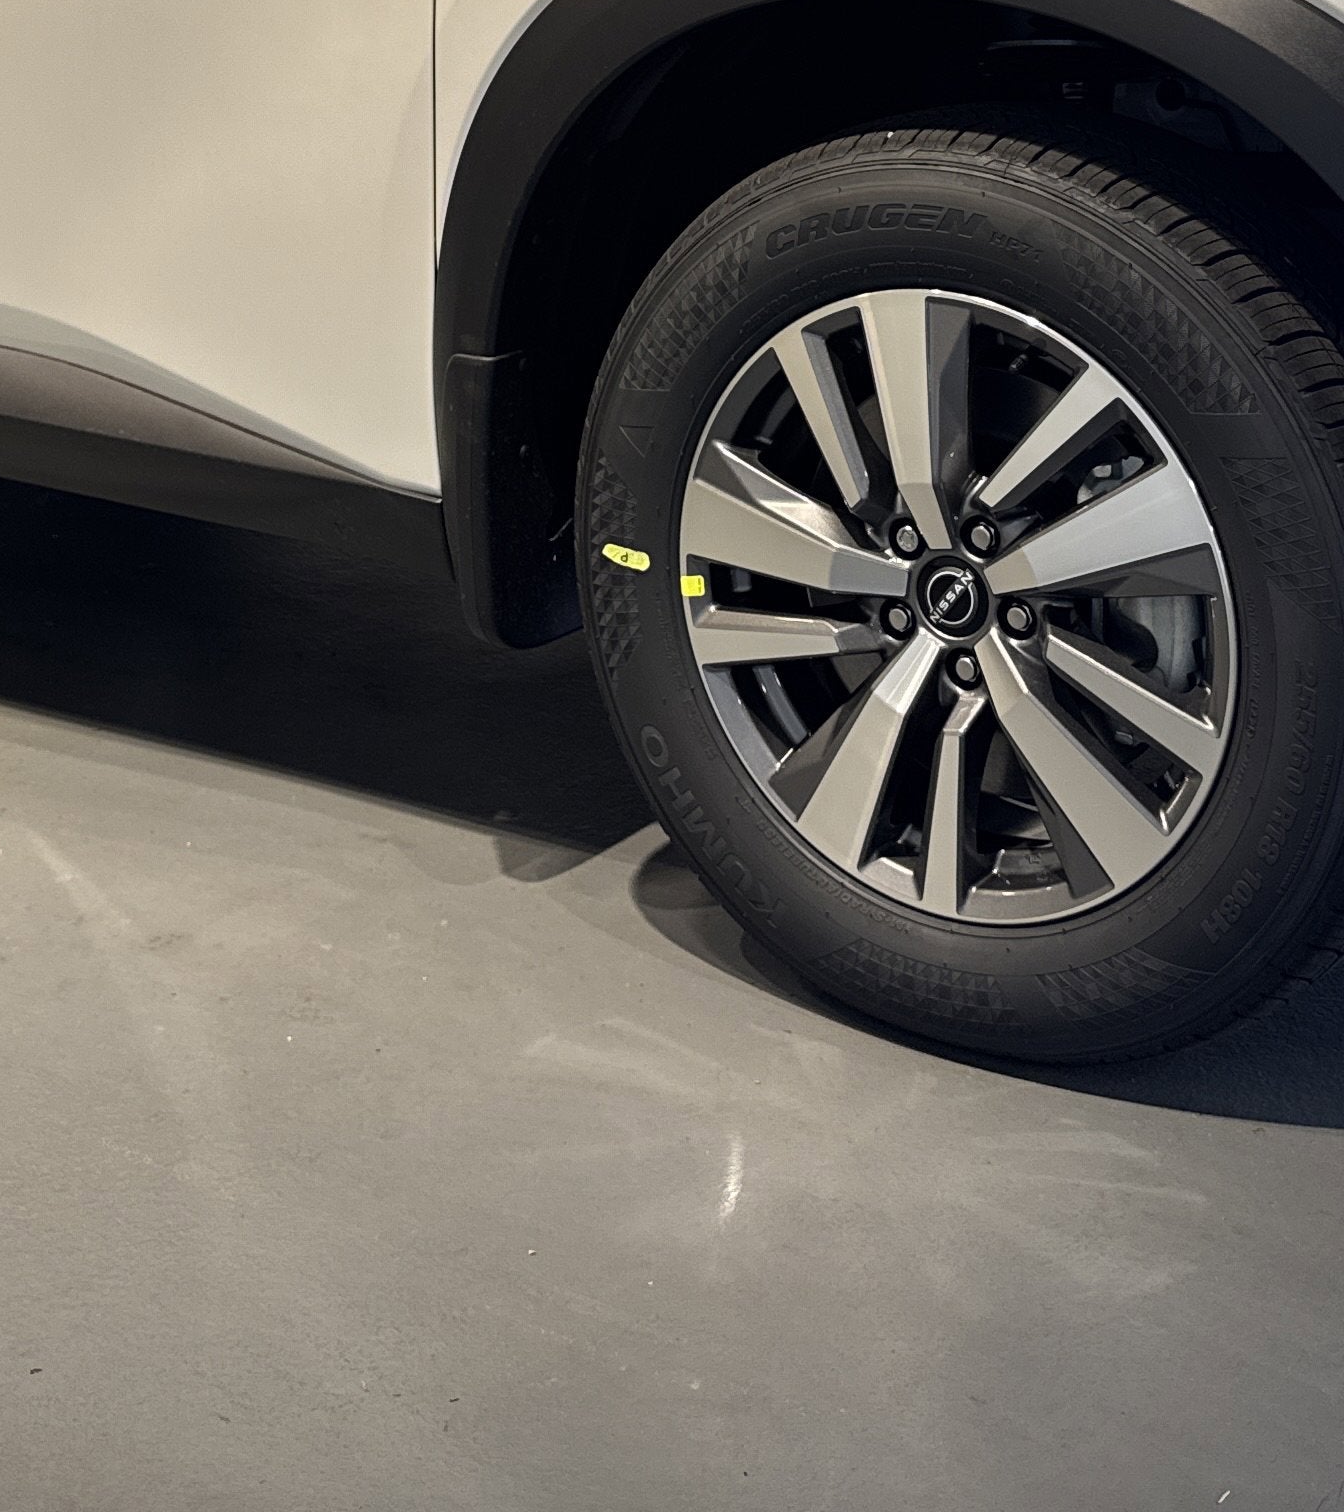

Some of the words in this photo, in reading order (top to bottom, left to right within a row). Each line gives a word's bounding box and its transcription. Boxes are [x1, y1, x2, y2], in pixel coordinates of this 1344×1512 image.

[765, 203, 988, 260] CRUGEN
[929, 570, 974, 624] NISSAN
[641, 723, 785, 930] KUMHO
